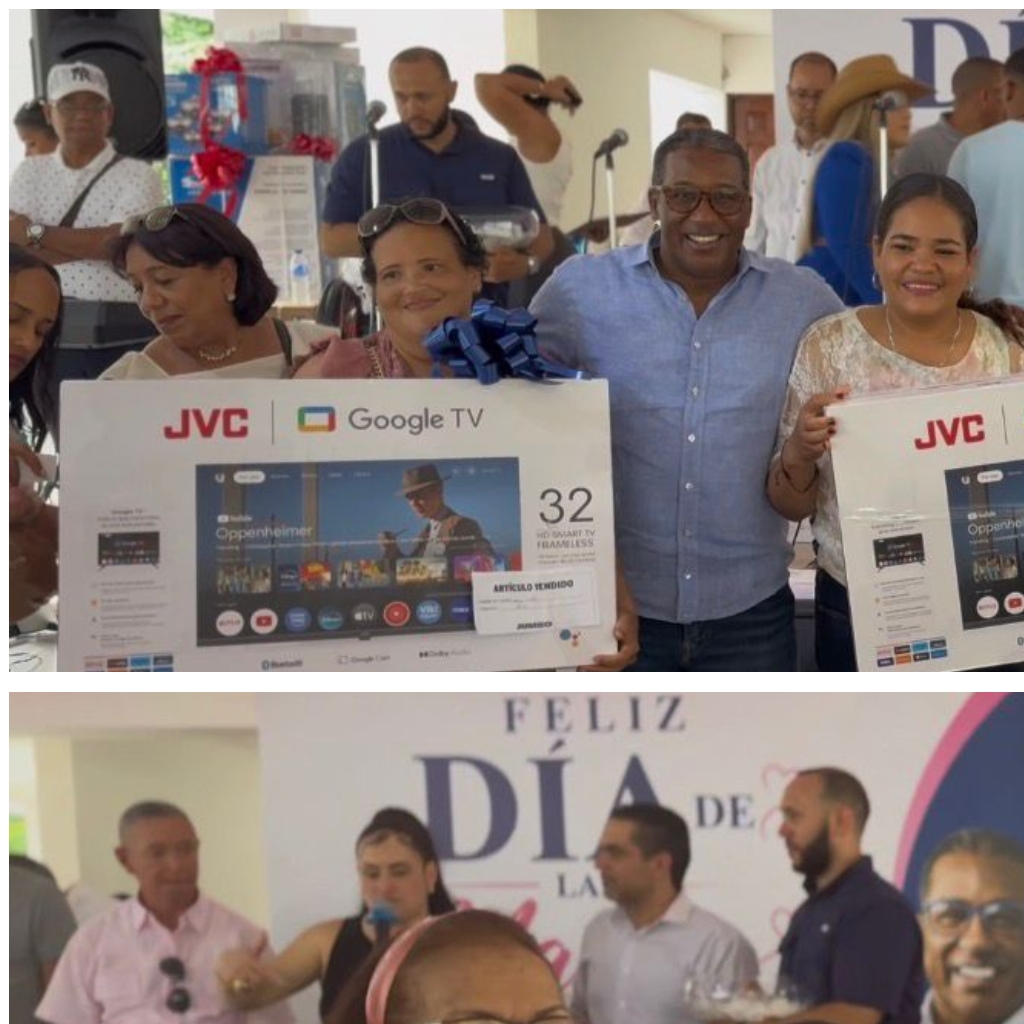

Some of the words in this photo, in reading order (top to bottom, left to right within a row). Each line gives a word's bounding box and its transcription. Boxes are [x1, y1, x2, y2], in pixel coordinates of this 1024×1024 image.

[163, 408, 249, 439] JVC
[348, 406, 444, 435] Google
[450, 407, 484, 428] TV
[914, 414, 986, 450] JVC
[539, 487, 594, 524] 32
[216, 525, 313, 541] Oppenheimer
[537, 539, 595, 550] FRAMELESS
[493, 579, 532, 592] ARTÍCULO
[504, 696, 687, 734] FELIZ
[695, 793, 755, 829] DE
[557, 873, 599, 898] LA
